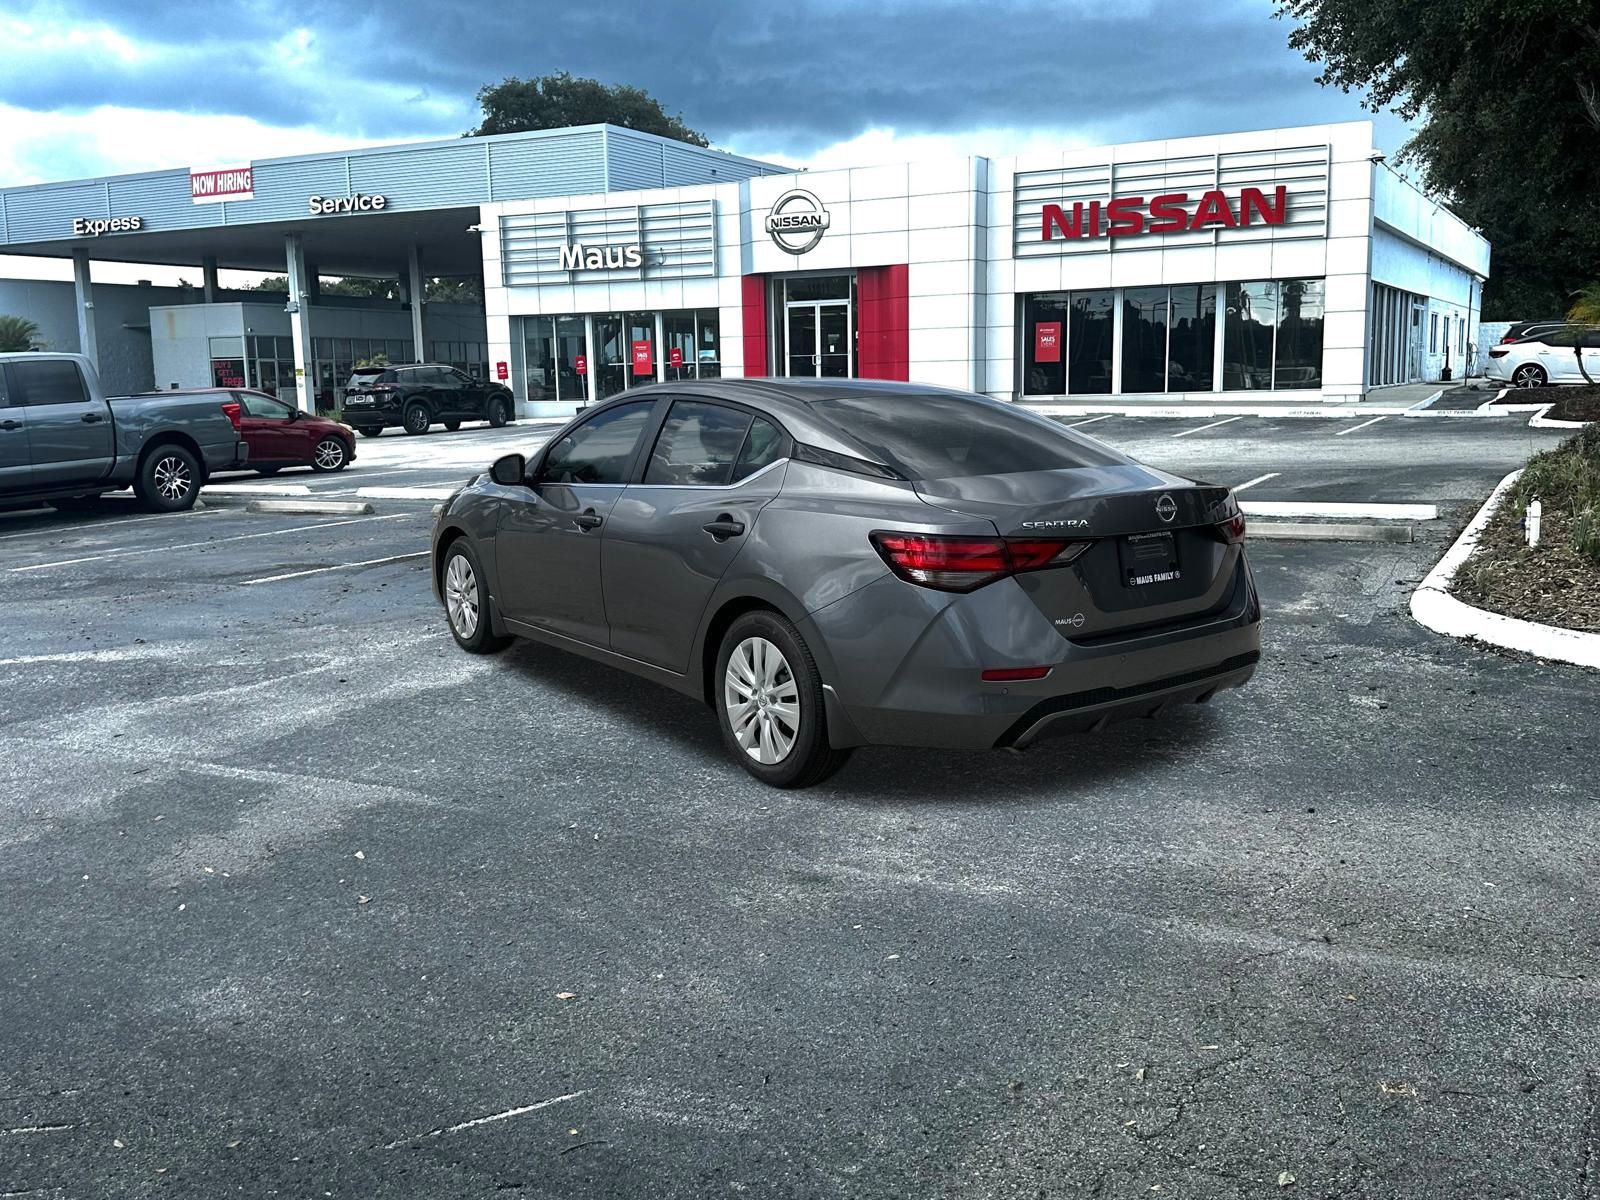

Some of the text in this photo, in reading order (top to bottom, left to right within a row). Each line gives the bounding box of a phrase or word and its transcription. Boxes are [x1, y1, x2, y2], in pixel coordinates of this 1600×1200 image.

[192, 171, 251, 195] NOW HIRING
[309, 193, 386, 215] Service
[1042, 185, 1287, 241] NISSAN
[73, 216, 141, 237] Express
[770, 215, 822, 228] NISSAN
[559, 243, 642, 270] Maus
[223, 377, 244, 387] FREE
[1022, 519, 1089, 530] SENTRA
[1136, 571, 1174, 584] MAUS FAMILY
